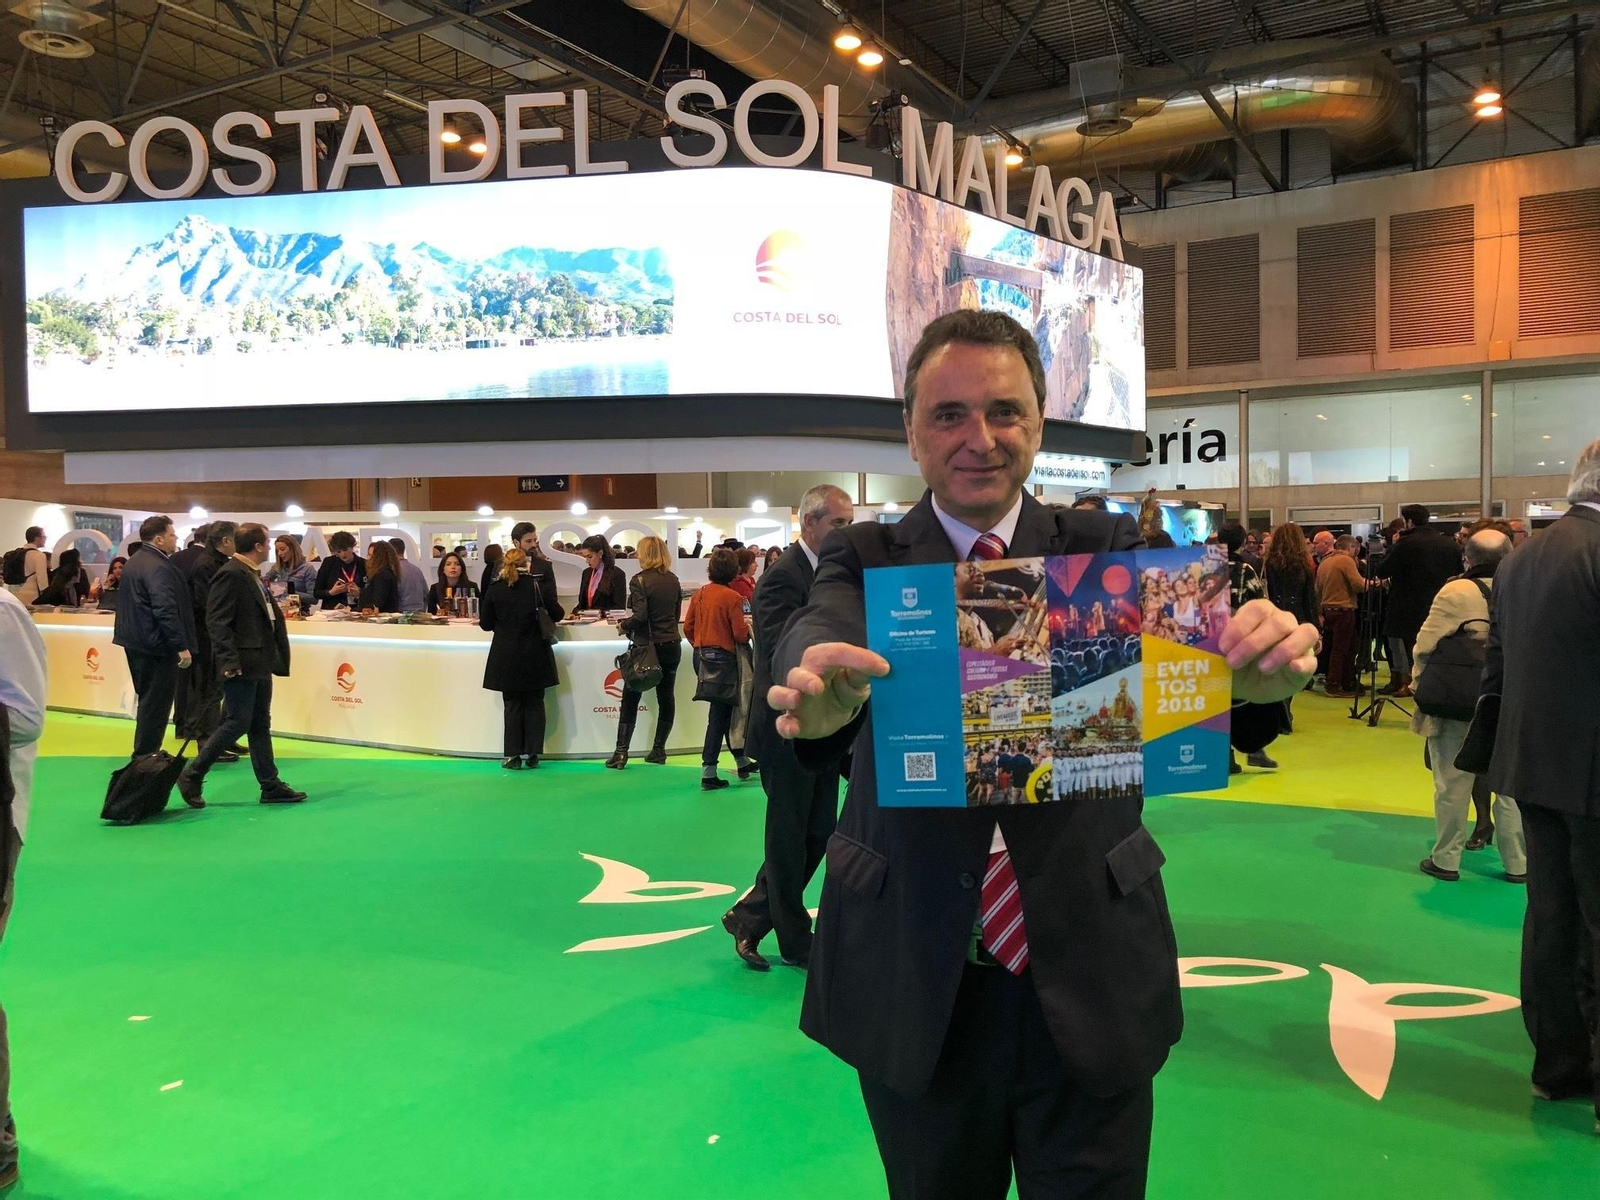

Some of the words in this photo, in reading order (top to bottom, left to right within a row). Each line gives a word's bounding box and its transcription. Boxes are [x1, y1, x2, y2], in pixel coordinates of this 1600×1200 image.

[55, 105, 401, 203] COSTA
[428, 89, 629, 184] DEL
[660, 79, 873, 177] SOL
[902, 105, 1125, 262] MALAGA
[733, 311, 781, 323] COSTA
[786, 312, 813, 324] DEL
[817, 313, 842, 325] SOL
[1157, 659, 1210, 678] EVEN
[1156, 678, 1197, 695] TOS
[1157, 695, 1206, 714] 2018
